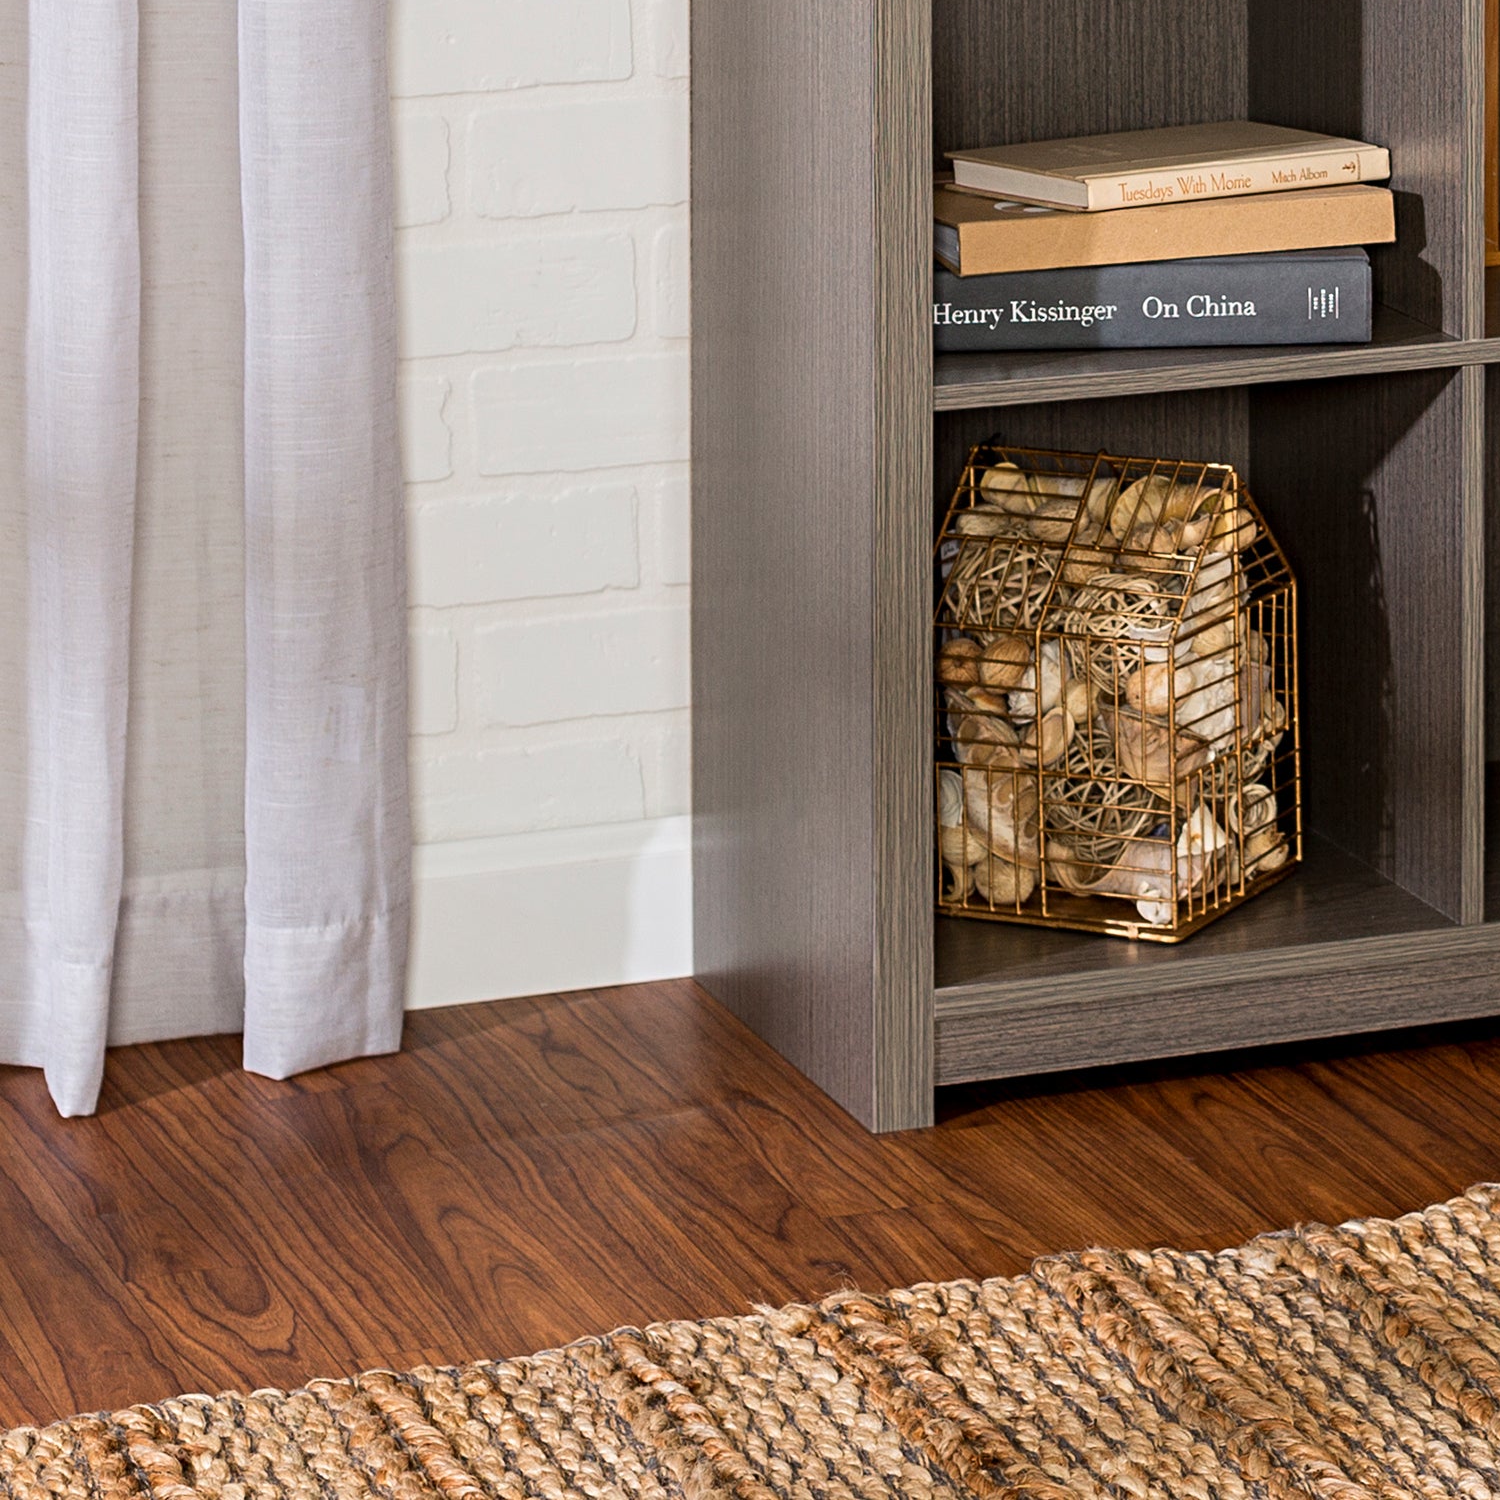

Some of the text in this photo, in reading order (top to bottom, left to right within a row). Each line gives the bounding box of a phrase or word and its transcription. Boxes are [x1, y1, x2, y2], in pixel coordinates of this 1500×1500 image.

[1118, 180, 1174, 202] Tuesdays
[1176, 175, 1207, 195] With
[1210, 172, 1252, 191] Morrie
[1299, 167, 1328, 181] Albom
[933, 294, 1257, 330] Henry Kissinger On China
